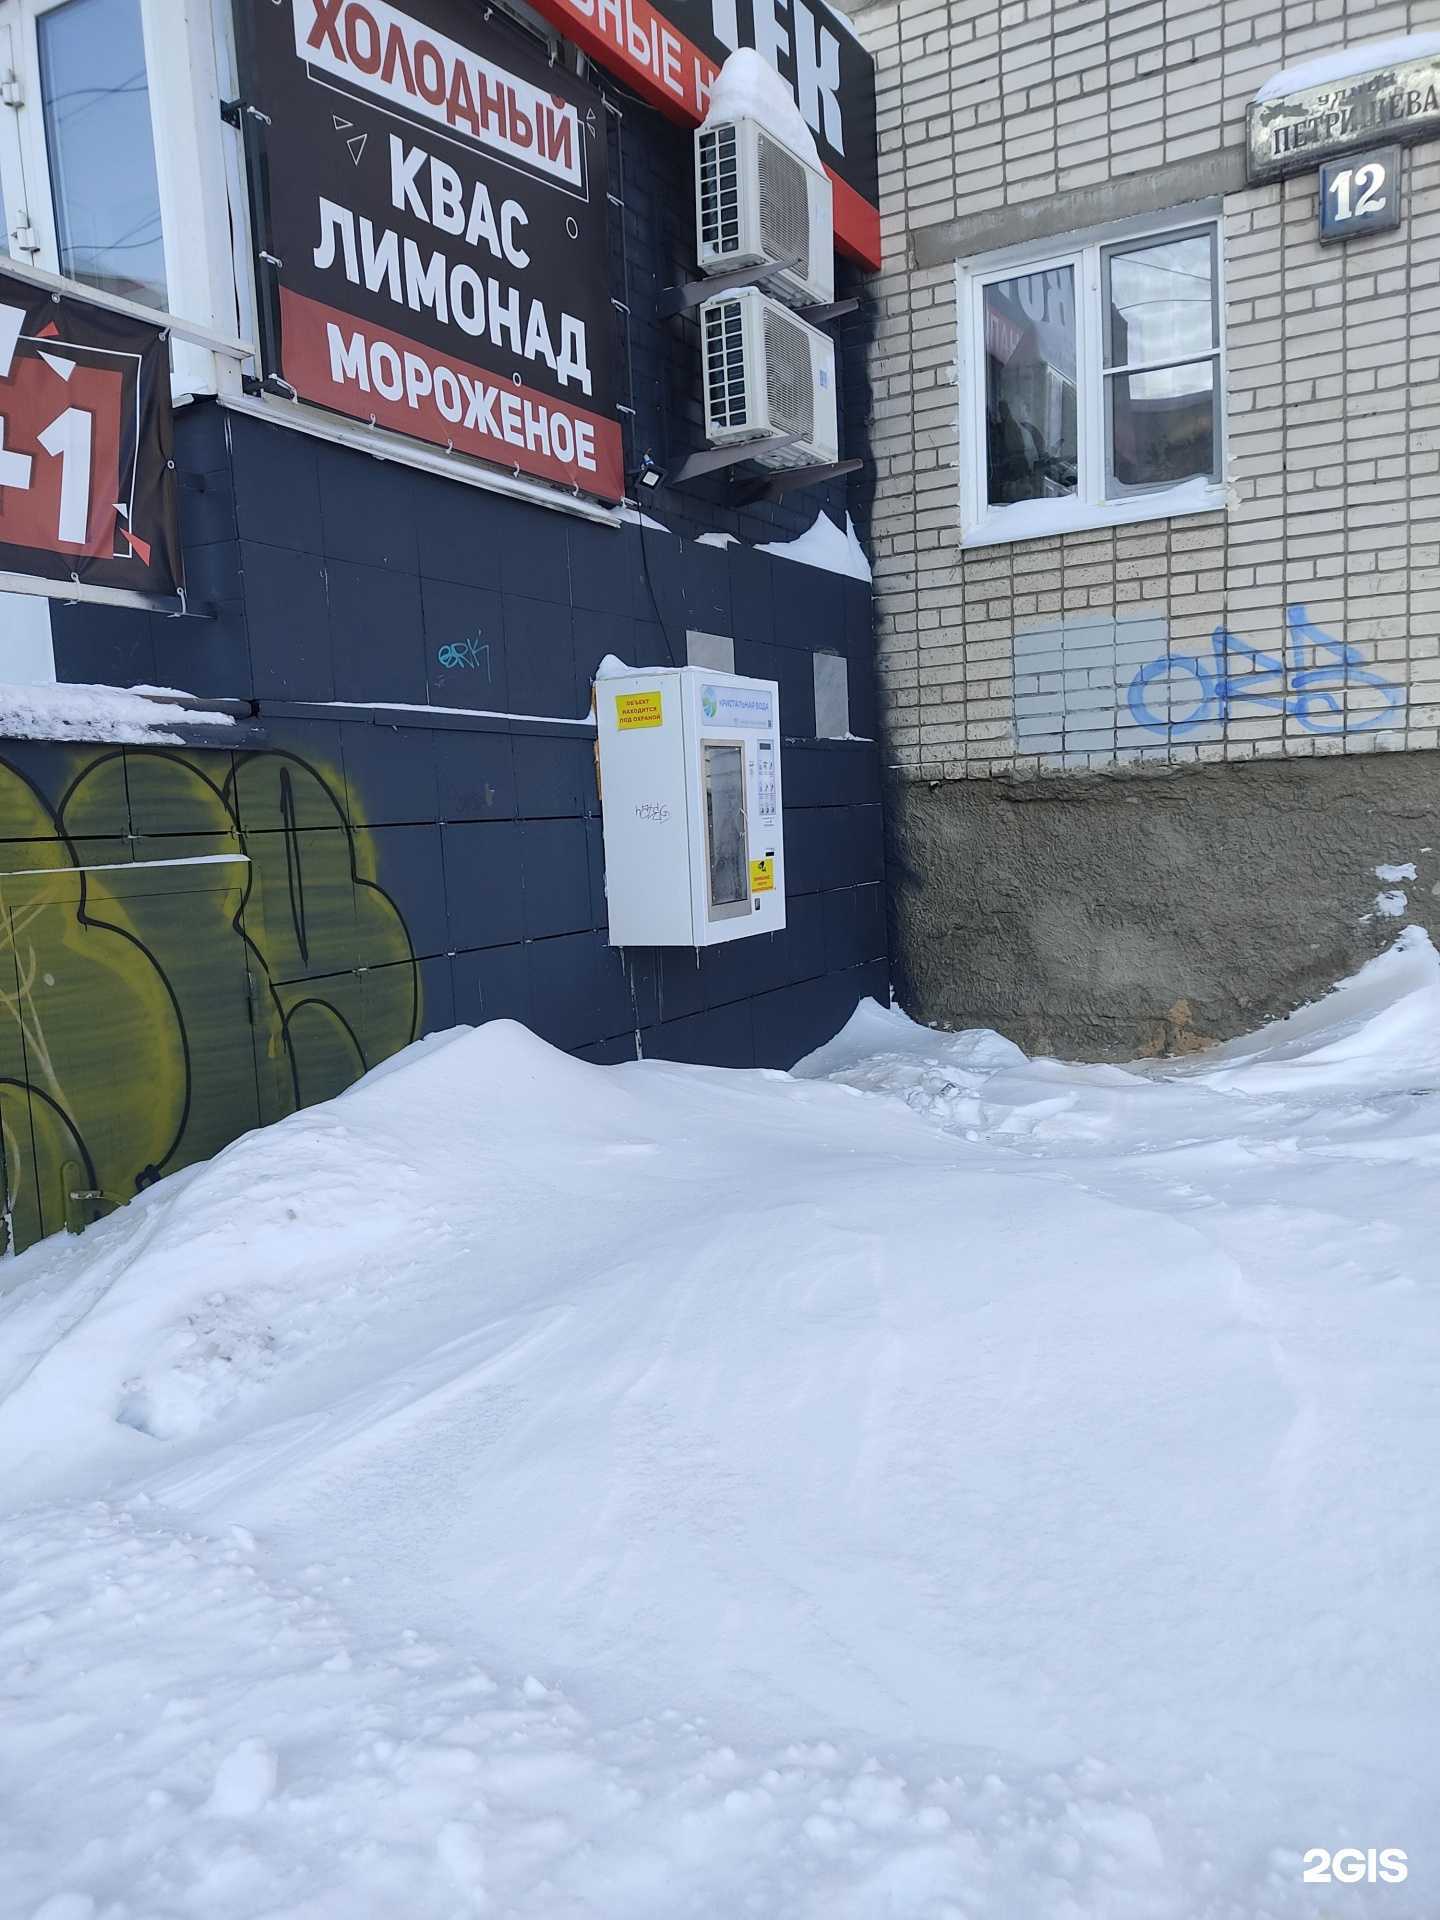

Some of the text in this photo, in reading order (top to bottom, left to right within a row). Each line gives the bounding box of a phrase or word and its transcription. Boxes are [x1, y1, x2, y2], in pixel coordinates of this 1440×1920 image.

[306, 0, 573, 171] ХОЛОДНЫЙ
[388, 133, 530, 269] КВАС
[1328, 163, 1386, 221] 12
[313, 196, 593, 396] ЛИМОНАД
[326, 322, 597, 473] МОРОЖЕНОЕ
